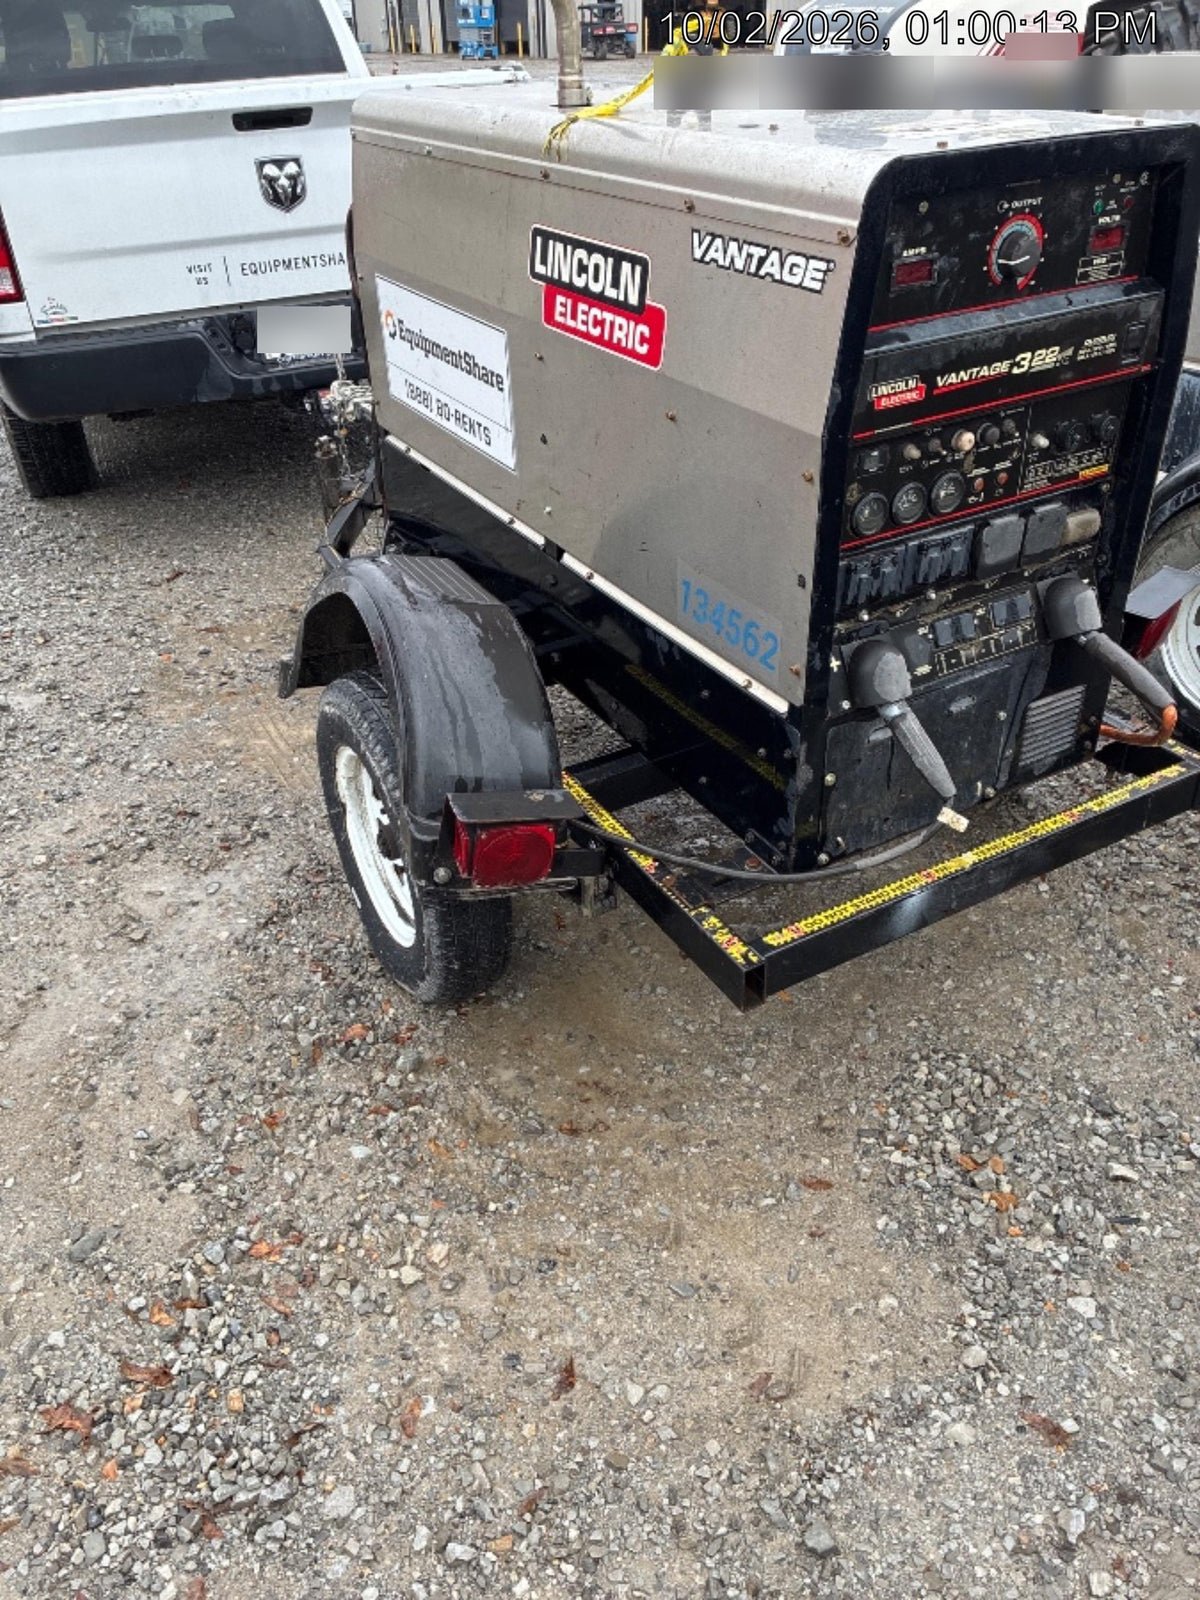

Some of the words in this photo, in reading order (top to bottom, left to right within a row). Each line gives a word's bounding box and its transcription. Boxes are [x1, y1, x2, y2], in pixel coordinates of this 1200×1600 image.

[1011, 197, 1042, 208] OUTPUT
[186, 262, 212, 275] VISIT
[240, 251, 346, 277] EQUIPMENTSHA
[534, 235, 642, 306] LINCOLN
[692, 229, 835, 293] VANTAGE
[195, 276, 209, 286] US
[554, 294, 650, 355] ELECTRIC
[397, 317, 504, 393] EquipmentShare
[936, 359, 1013, 388] VANTAGE
[1011, 345, 1061, 374] 322
[870, 377, 918, 398] LINCOLN
[881, 389, 920, 407] ELECTRIC
[682, 579, 780, 672] 134562
